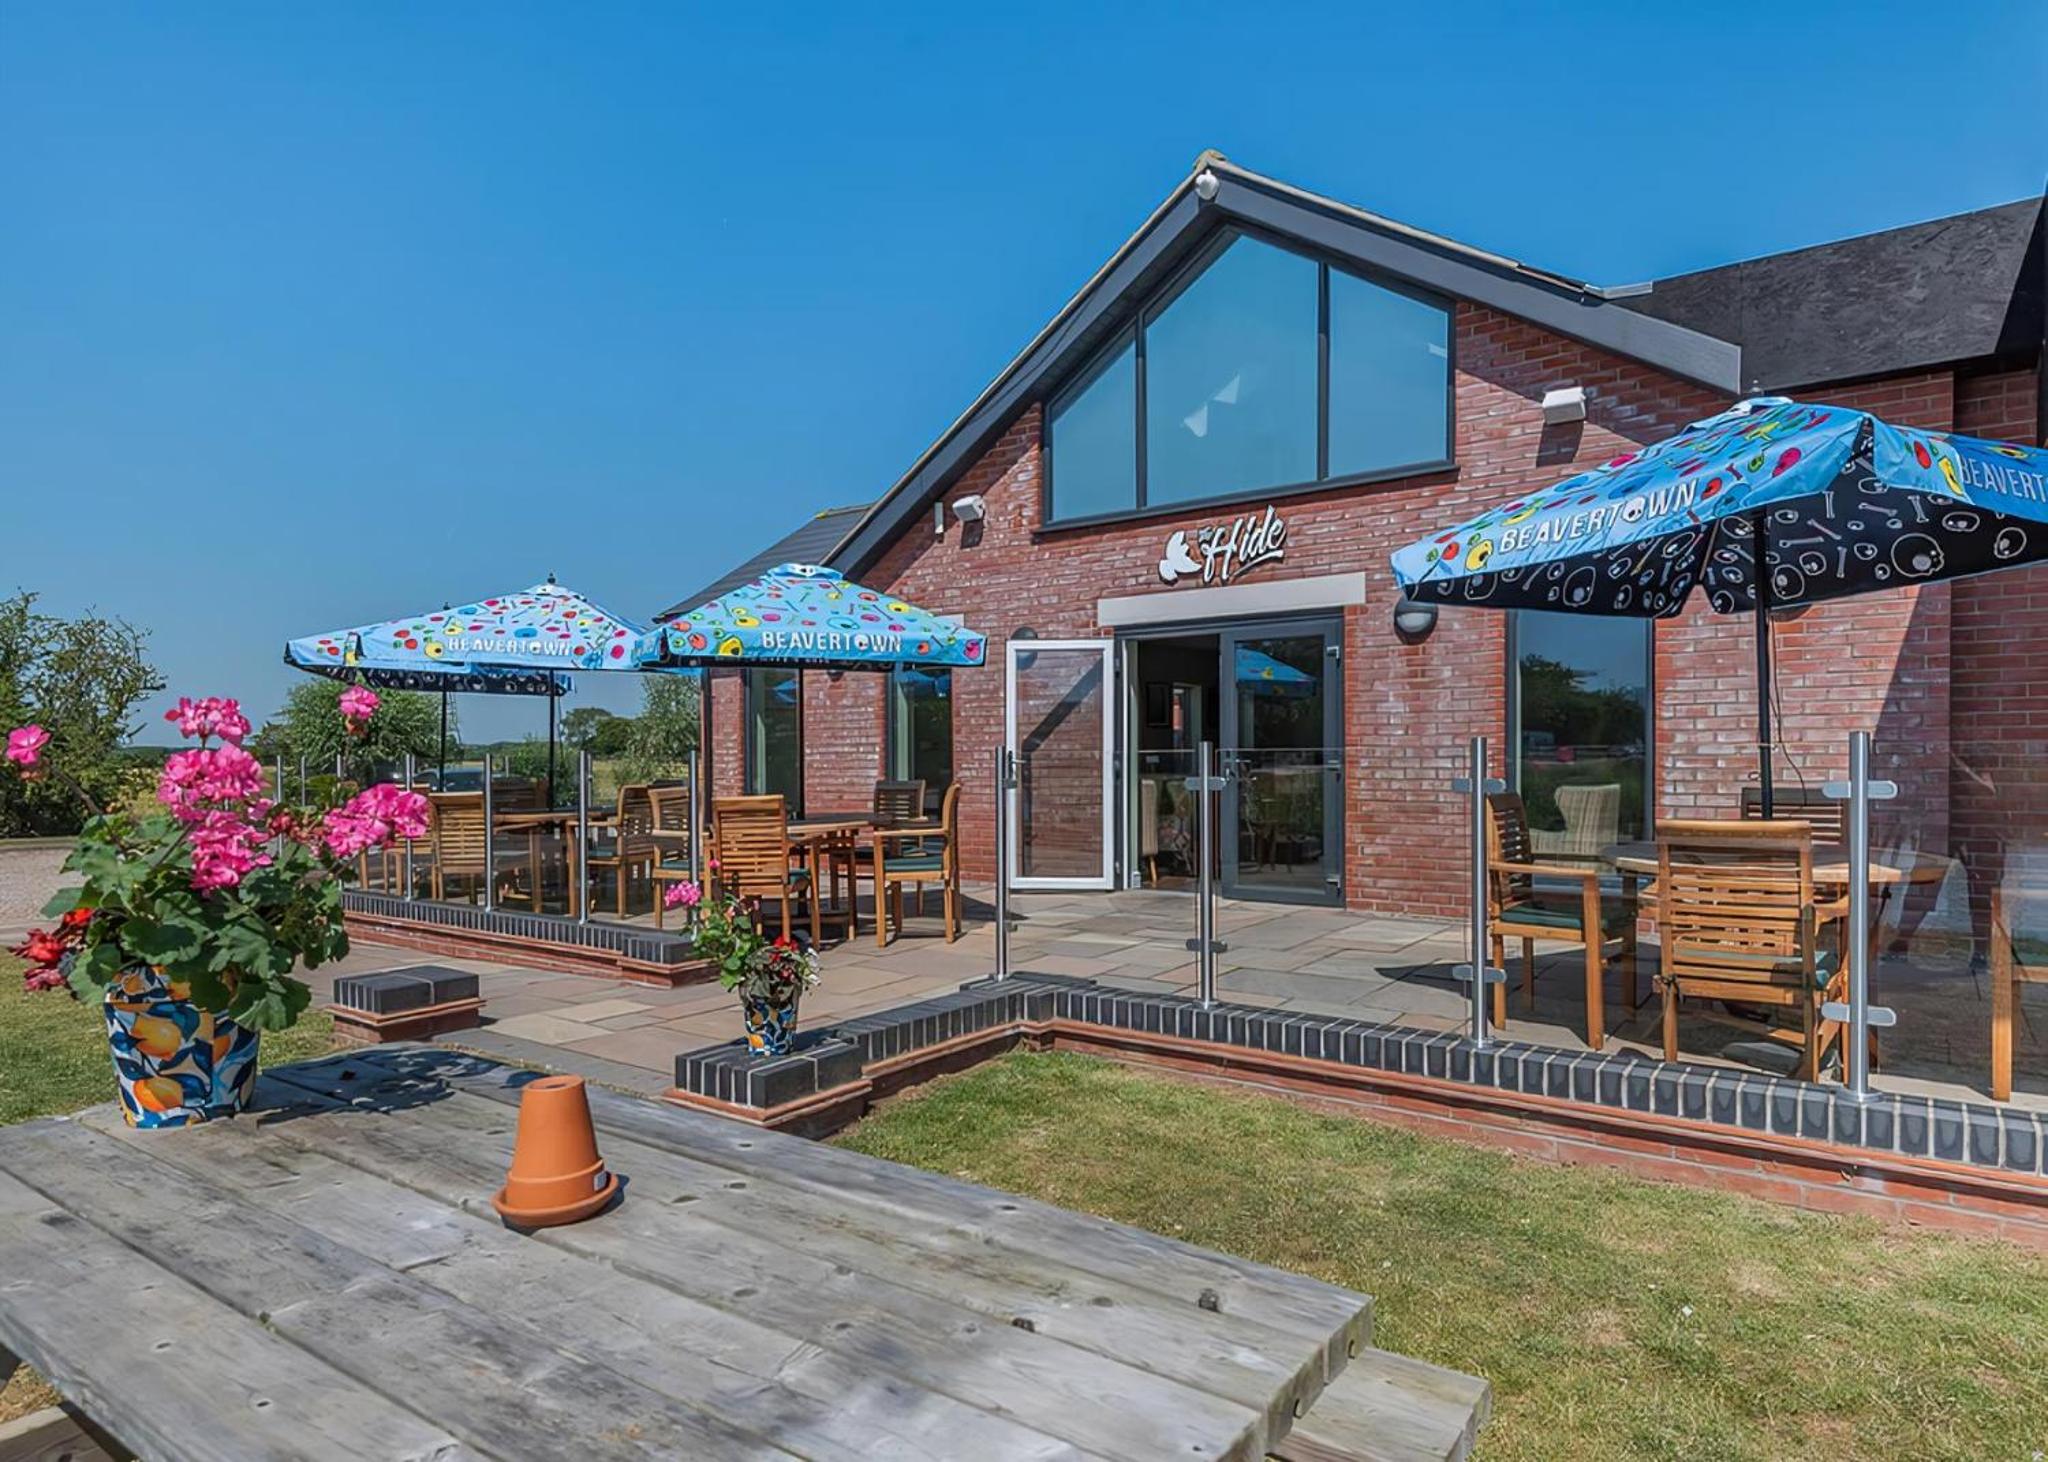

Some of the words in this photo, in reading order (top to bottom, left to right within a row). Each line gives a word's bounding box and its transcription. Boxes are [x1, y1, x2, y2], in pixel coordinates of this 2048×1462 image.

[1200, 504, 1287, 582] Hide
[1500, 478, 1699, 552] BEAVERTOWN
[762, 631, 901, 652] BEAVERTOWN
